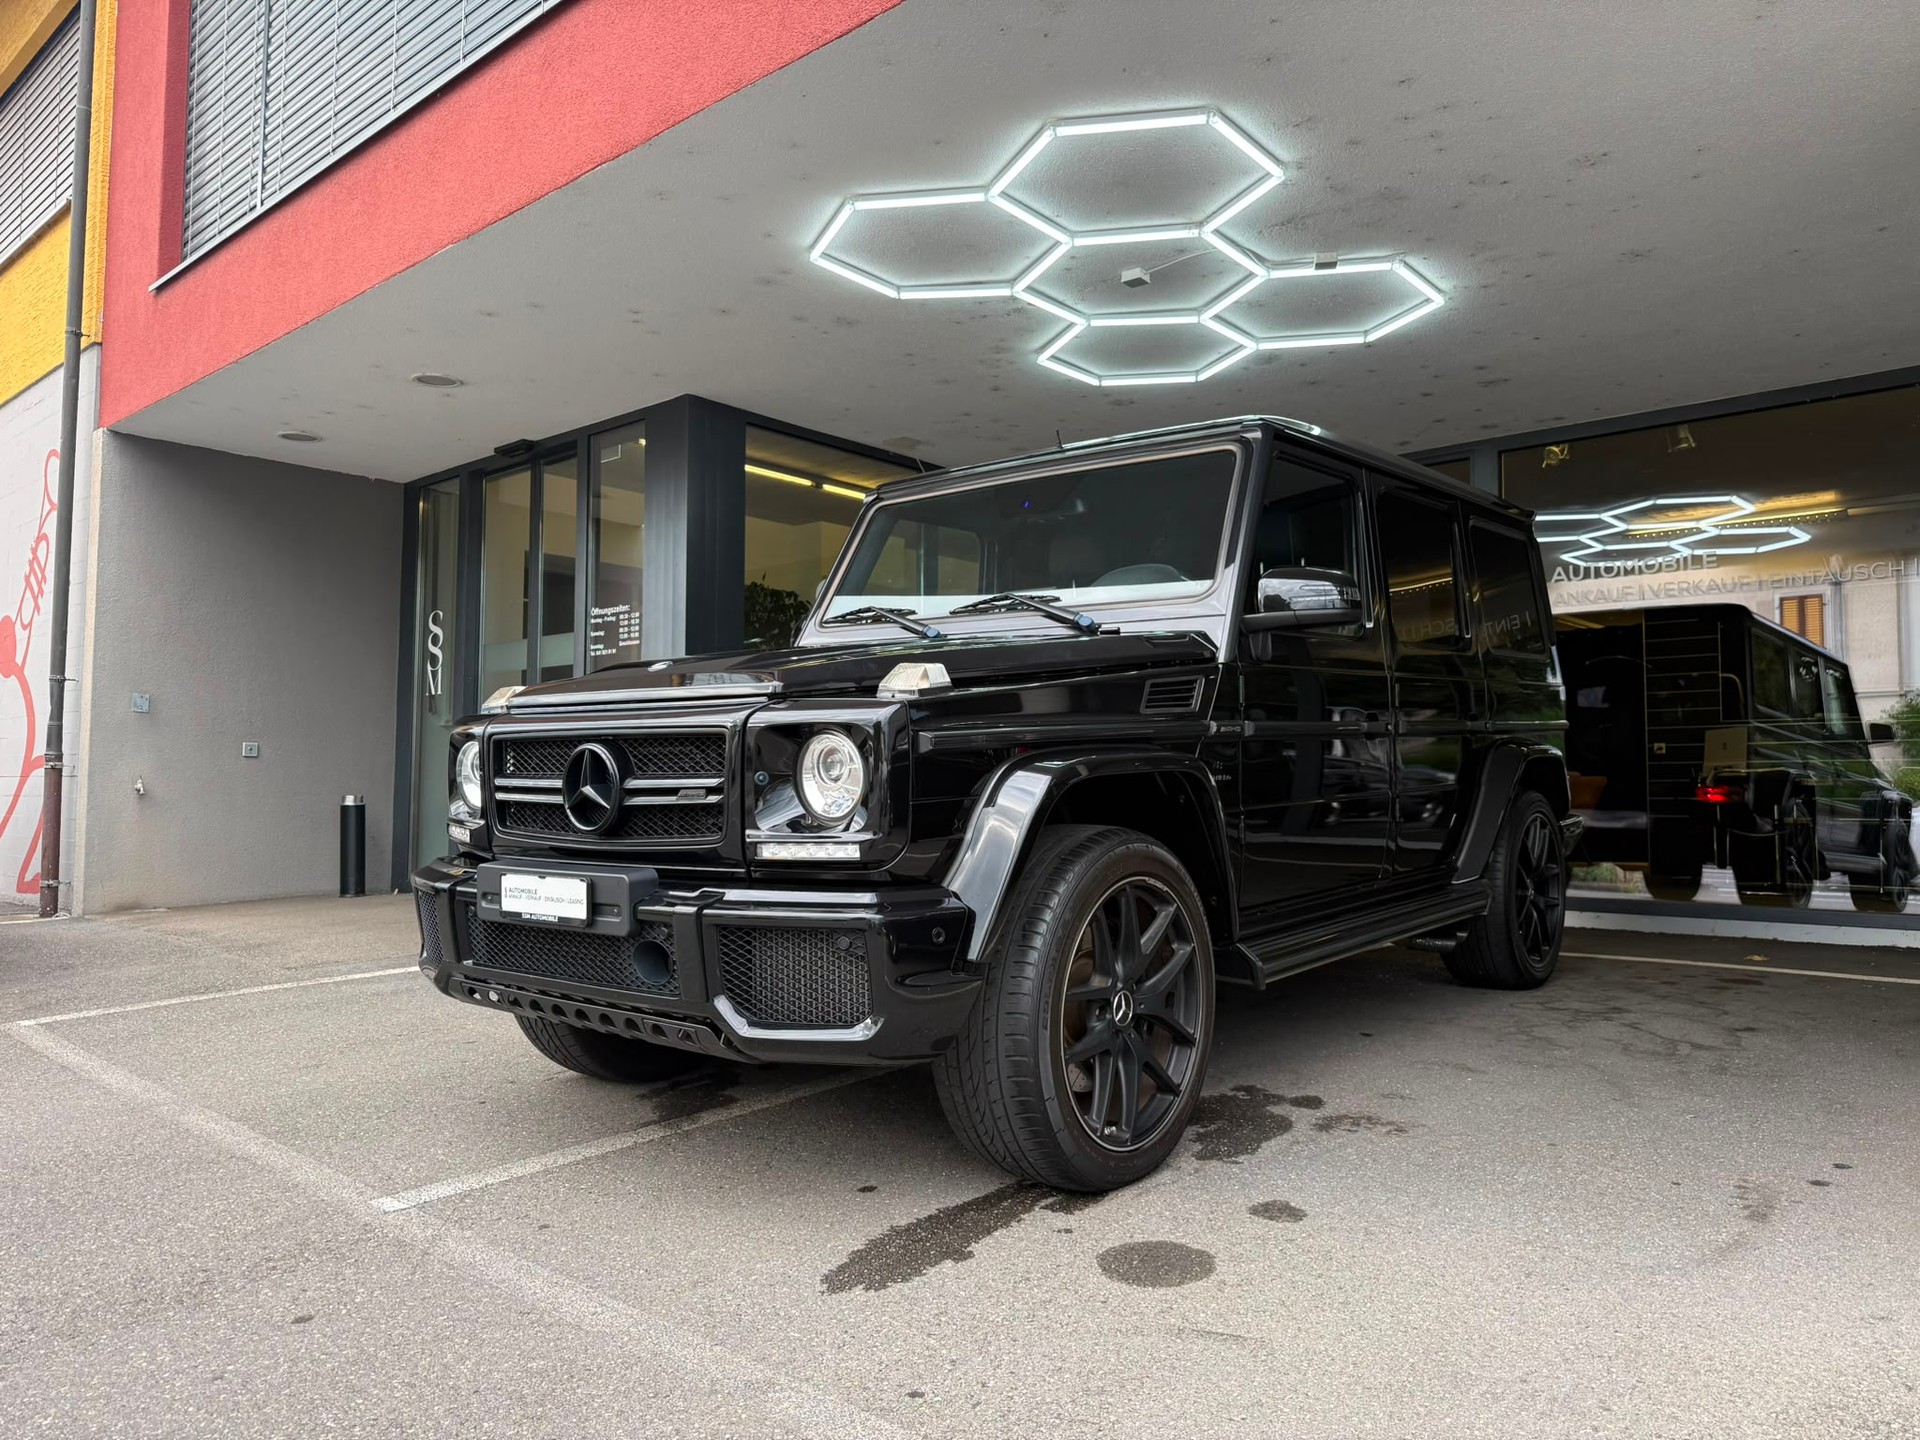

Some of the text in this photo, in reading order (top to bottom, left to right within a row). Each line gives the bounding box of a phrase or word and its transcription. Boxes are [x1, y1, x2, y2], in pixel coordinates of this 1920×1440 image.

[1551, 551, 1718, 583] AUTOMOBILE
[1552, 585, 1635, 606] ANKAUF
[1647, 576, 1750, 599] VERKAUF
[1768, 560, 1905, 589] EINTAUSCH
